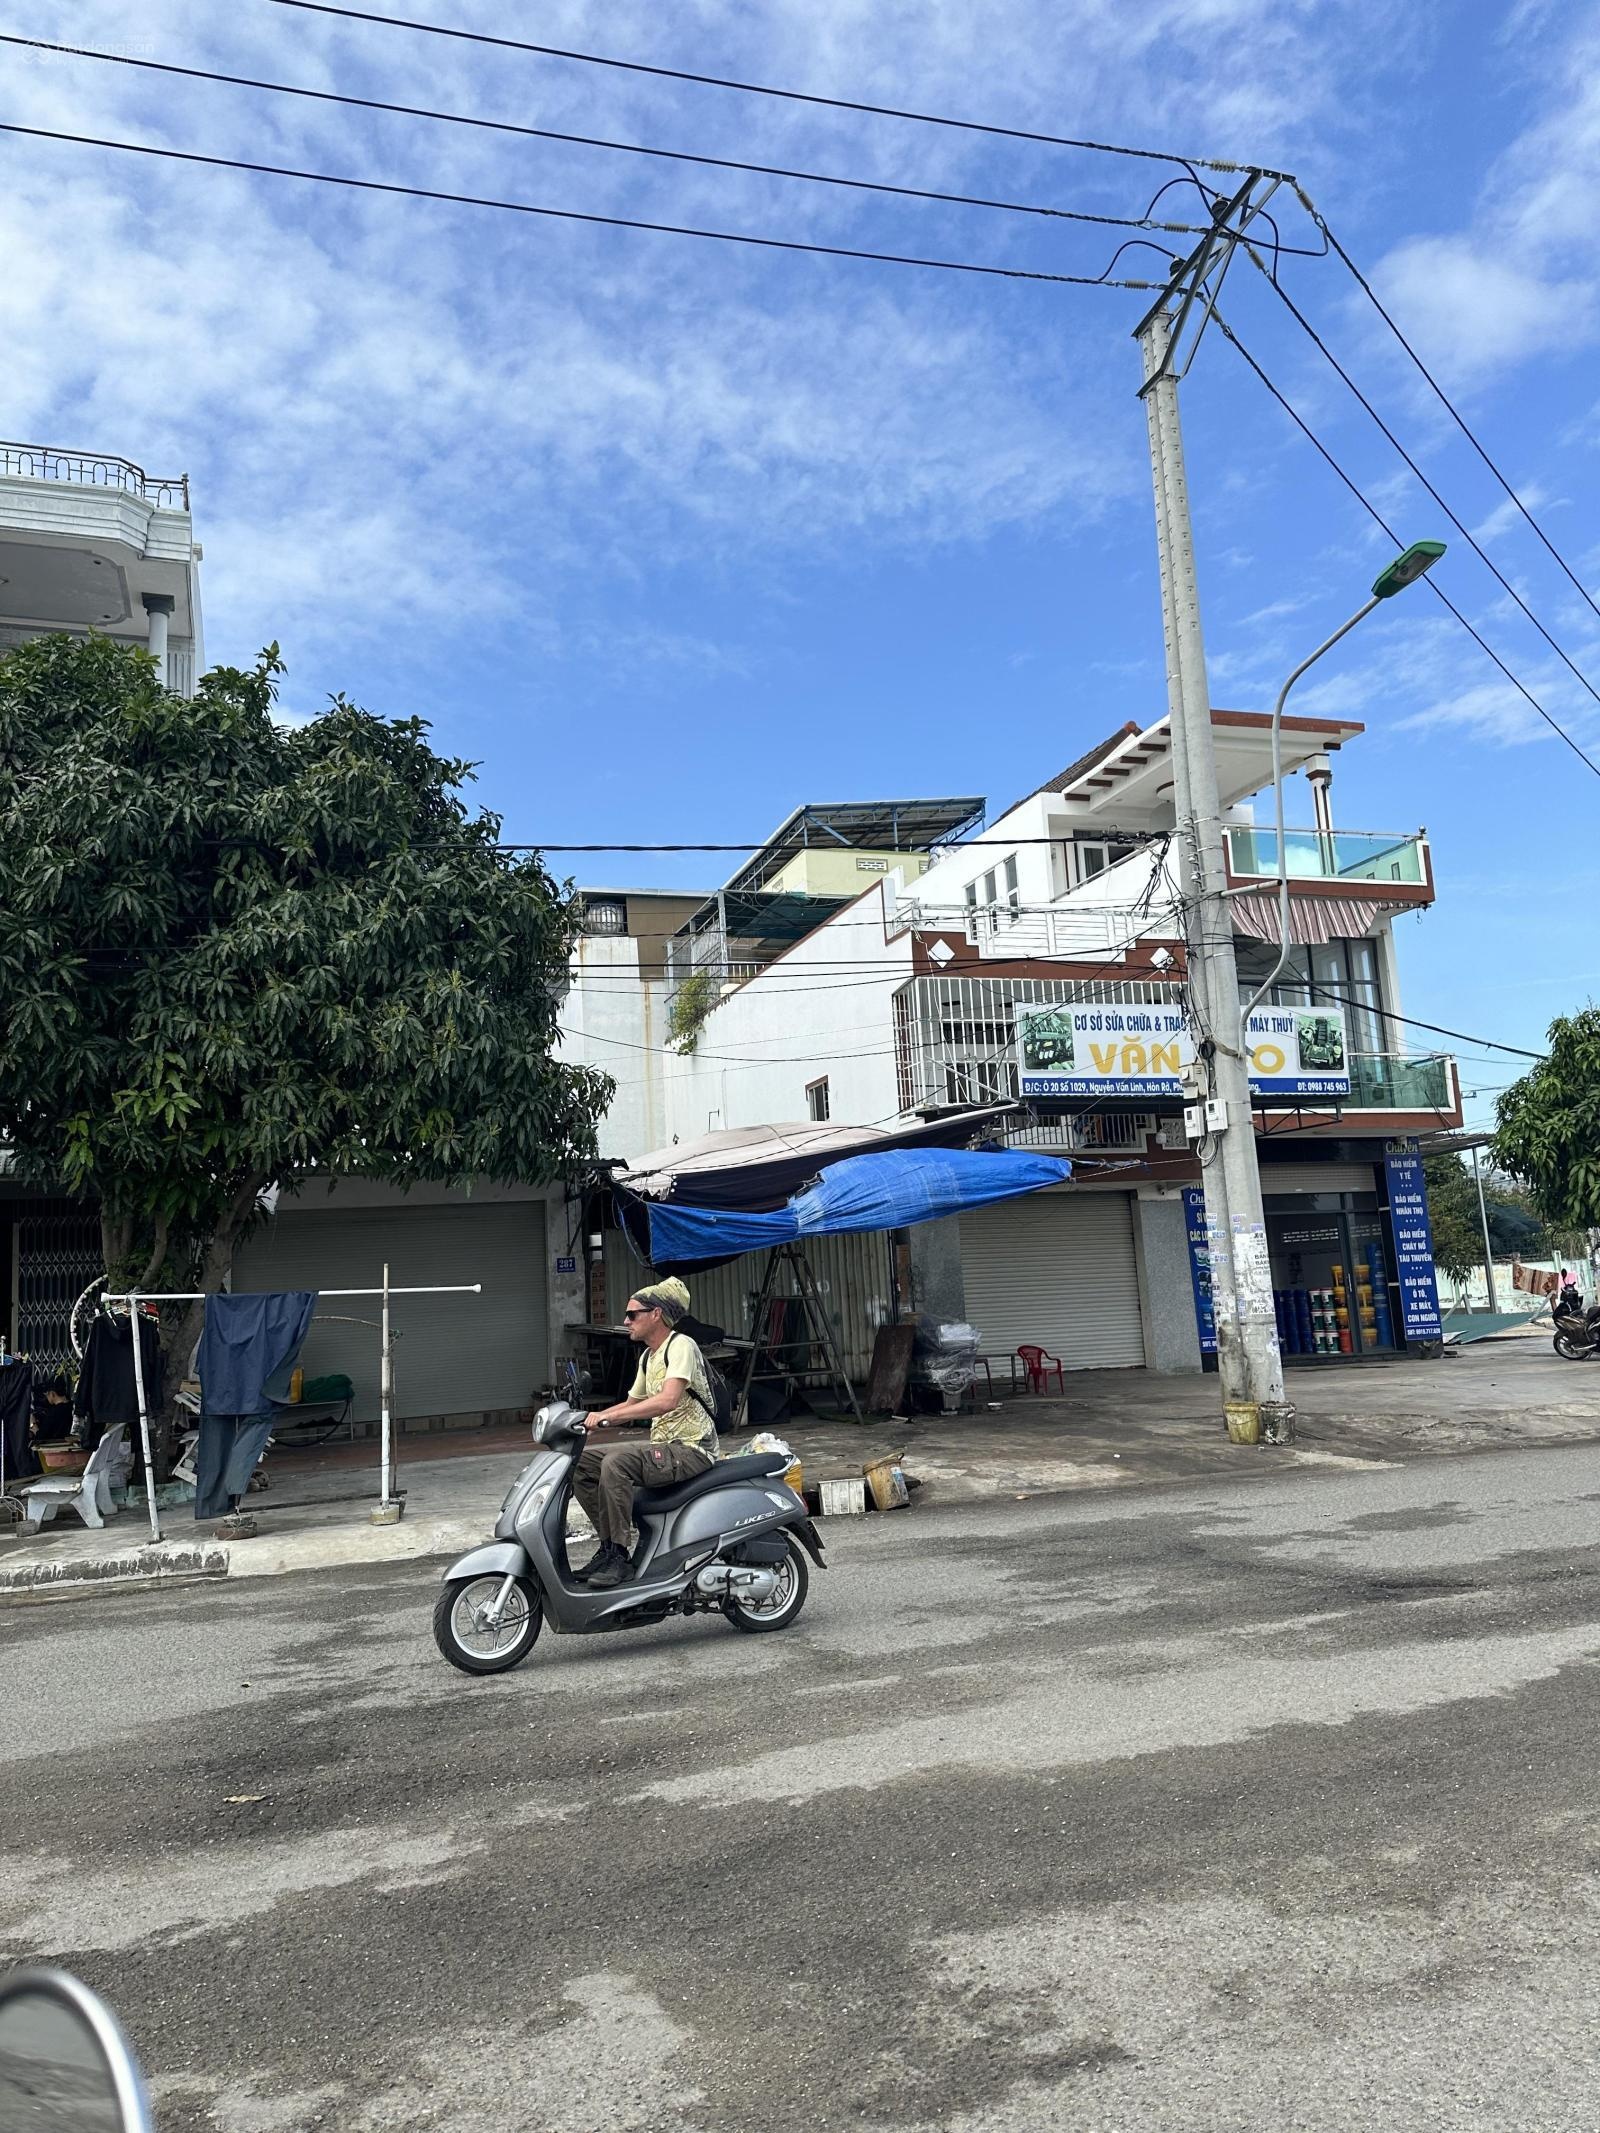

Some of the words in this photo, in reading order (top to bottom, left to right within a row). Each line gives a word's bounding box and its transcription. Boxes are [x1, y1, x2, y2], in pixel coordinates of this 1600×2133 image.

[1074, 1013, 1087, 1031] CƠ
[1089, 1009, 1103, 1031] SỞ
[1105, 1009, 1125, 1031] SỬA
[1126, 1012, 1152, 1031] CHỮA
[1154, 1016, 1162, 1032] &
[1250, 1013, 1269, 1033] MÁY
[1088, 1036, 1181, 1075] VĂN
[1025, 1081, 1042, 1093] Đ/C:
[1050, 1082, 1059, 1092] 20
[1060, 1080, 1069, 1092] Số
[1070, 1082, 1088, 1094] 1029,
[1089, 1079, 1115, 1095] Nguyễn
[1130, 1081, 1146, 1093] Linh,
[1146, 1081, 1160, 1092] Hòn
[1297, 1081, 1307, 1092] ĐT:
[1323, 1081, 1335, 1092] 745
[1335, 1081, 1347, 1092] 963
[1385, 1141, 1418, 1155] Chuyên
